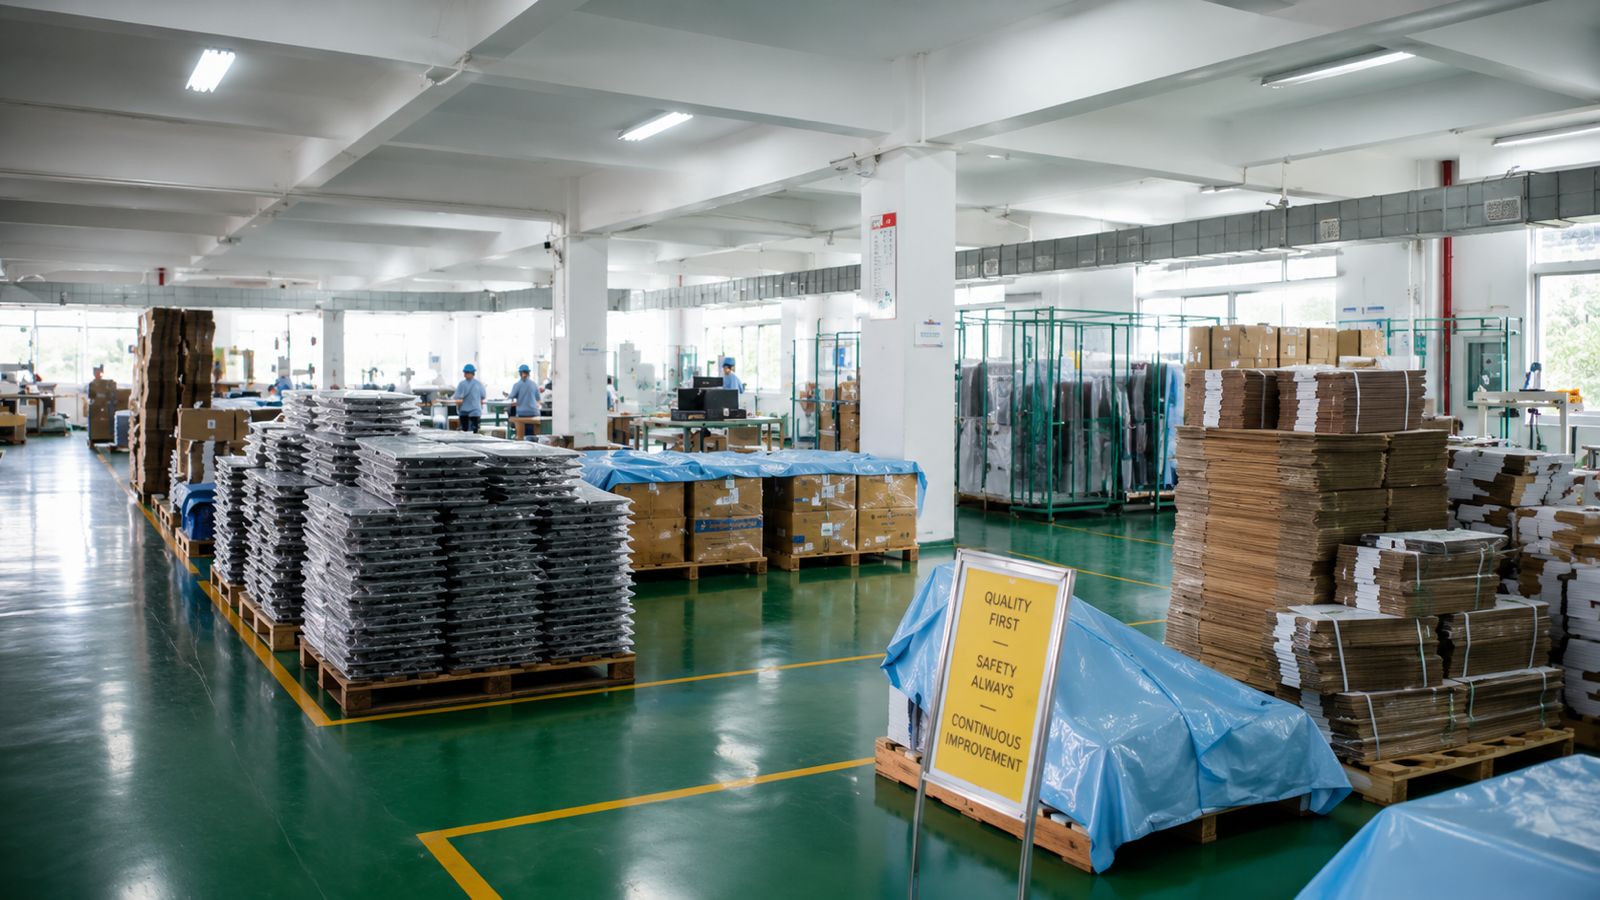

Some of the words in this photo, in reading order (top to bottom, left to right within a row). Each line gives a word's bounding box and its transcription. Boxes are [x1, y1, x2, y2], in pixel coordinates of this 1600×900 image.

[984, 591, 1032, 613] QUALITY
[989, 612, 1020, 632] FIRST
[976, 654, 1017, 678] SAFETY
[970, 674, 1015, 699] ALWAYS
[951, 713, 1022, 751] CONTINUOUS
[945, 732, 1023, 773] IMPROVEMENT
